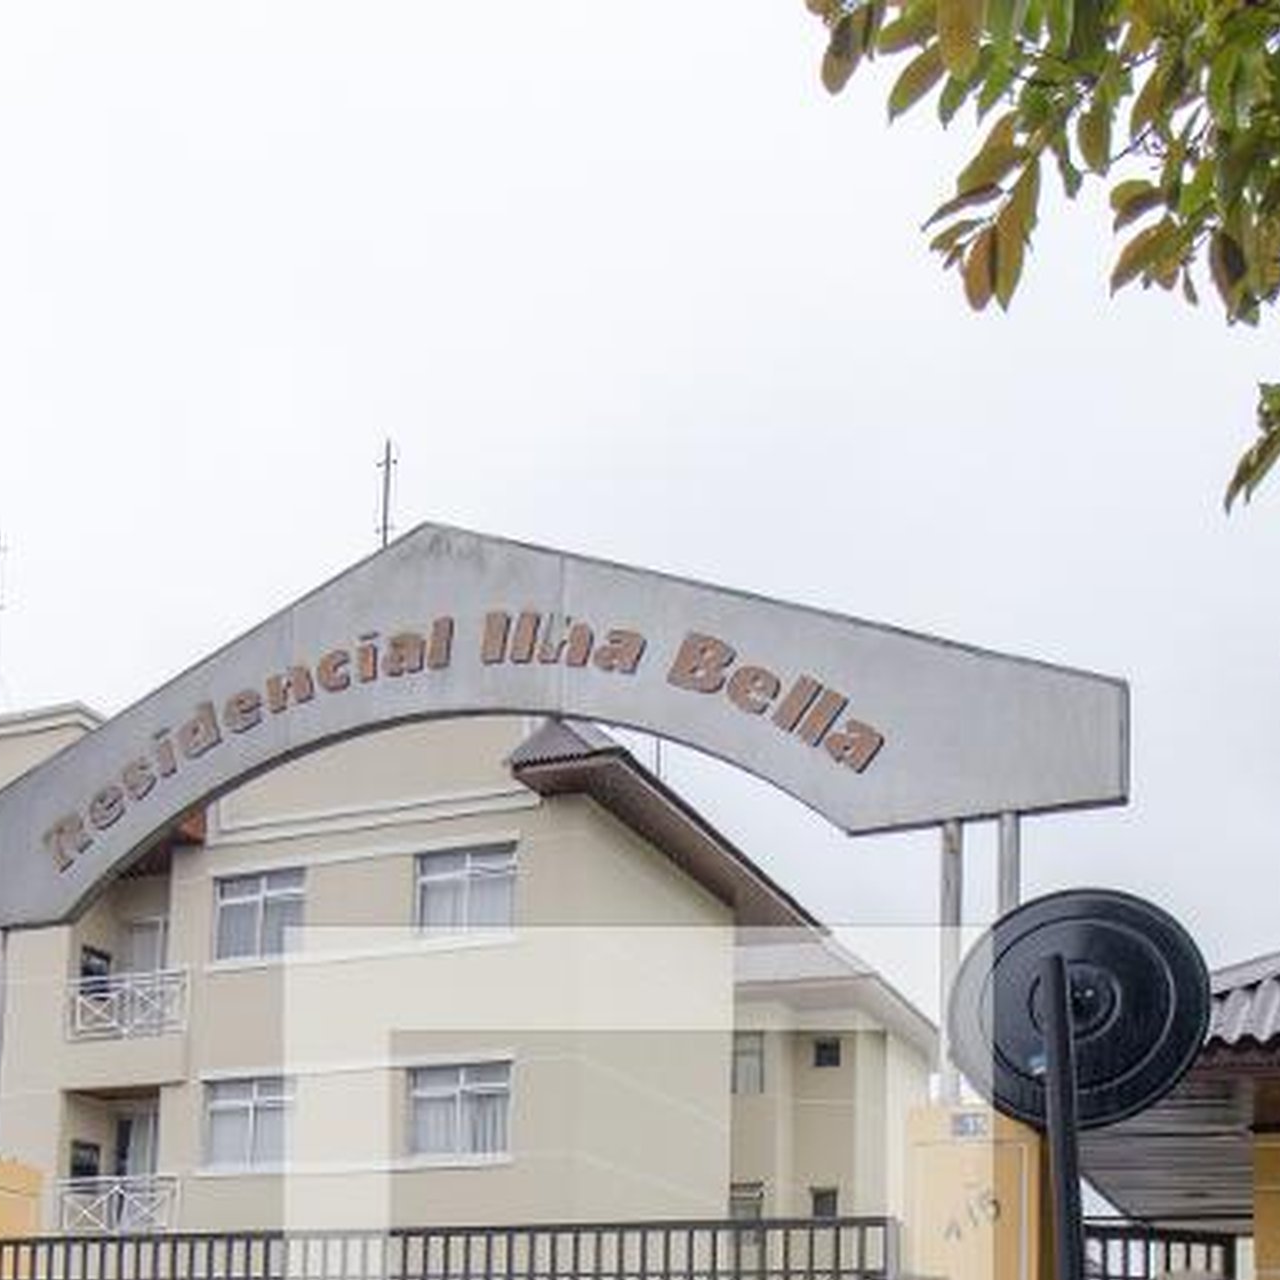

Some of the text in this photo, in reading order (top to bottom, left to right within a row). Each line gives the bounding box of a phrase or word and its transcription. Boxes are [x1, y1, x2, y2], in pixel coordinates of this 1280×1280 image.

[46, 610, 885, 873] Residencial Ilha Bella
